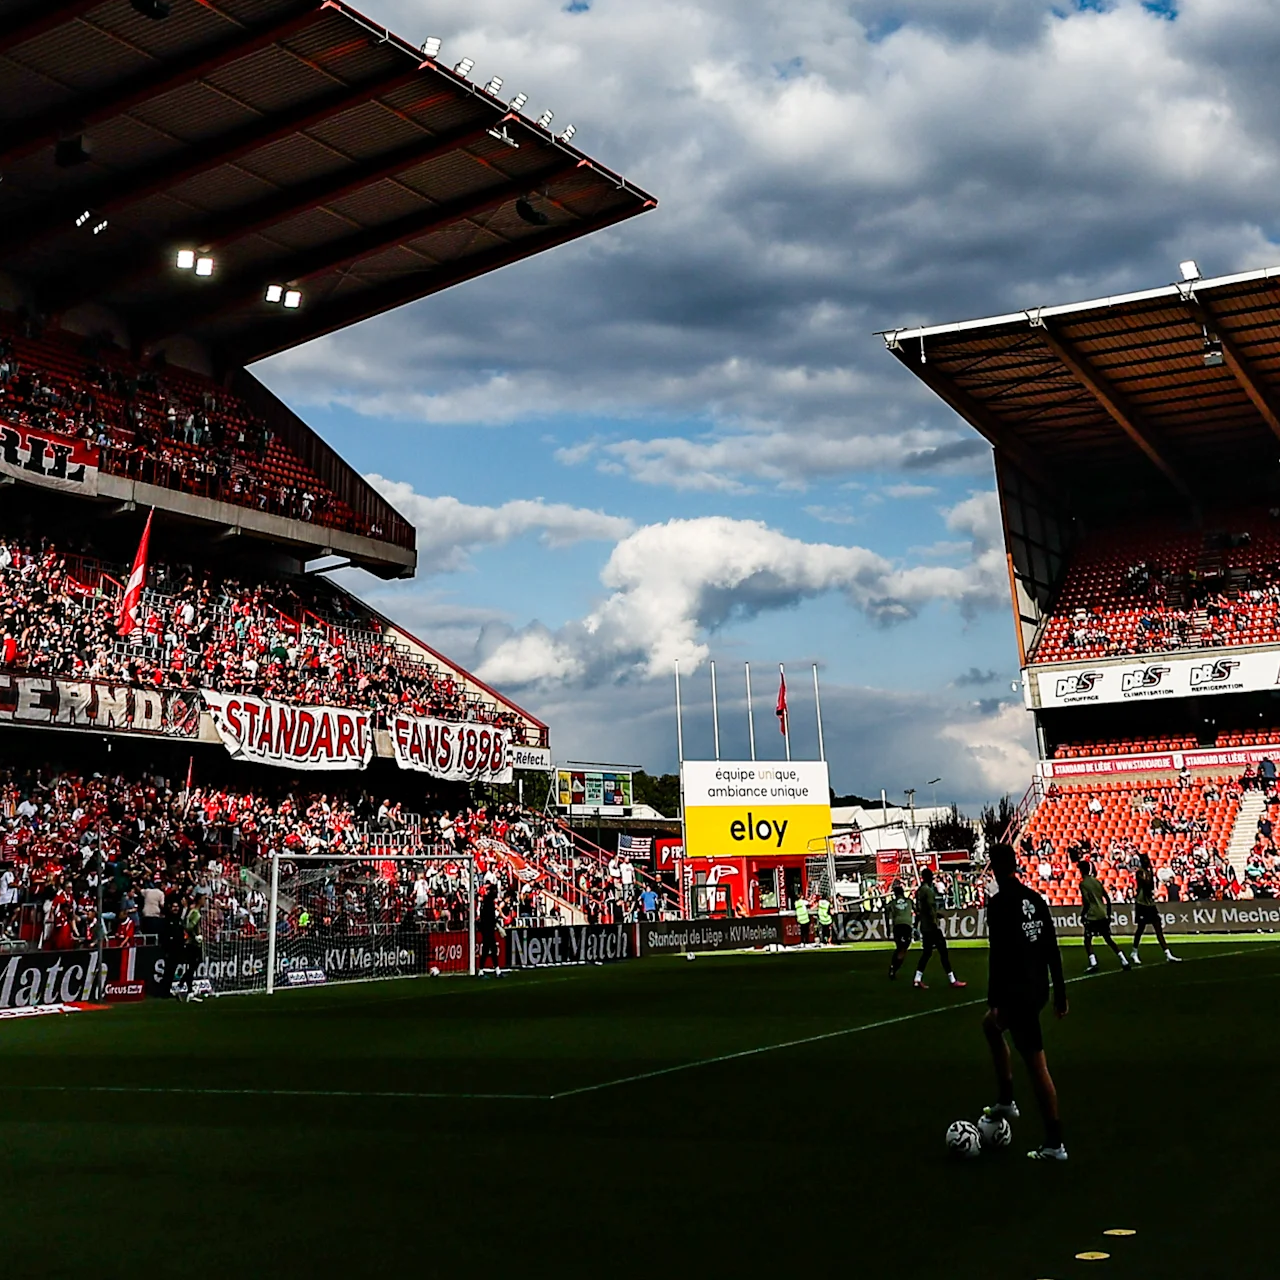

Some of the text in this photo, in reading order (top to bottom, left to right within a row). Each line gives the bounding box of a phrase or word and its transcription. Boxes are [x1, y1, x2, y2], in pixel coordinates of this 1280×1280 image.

[395, 719, 505, 775] FANS 1898
[1055, 763, 1085, 773] STANDARD
[1086, 763, 1093, 771] DE
[1186, 754, 1218, 765] STANDARD
[1218, 753, 1227, 763] DE
[715, 767, 800, 784] équipe unique,
[707, 785, 809, 800] ambiance unique
[730, 812, 788, 848] eloy
[1193, 908, 1218, 924] KV
[511, 929, 562, 967] Next
[568, 924, 628, 961] Match
[648, 930, 688, 948] Standard
[689, 929, 701, 944] de
[701, 927, 723, 947] Liège
[729, 925, 742, 942] KV
[742, 924, 778, 940] Mechelen
[242, 953, 263, 974] de
[324, 948, 348, 970] KV
[349, 945, 416, 969] Mechelen
[434, 939, 463, 961] 12/09
